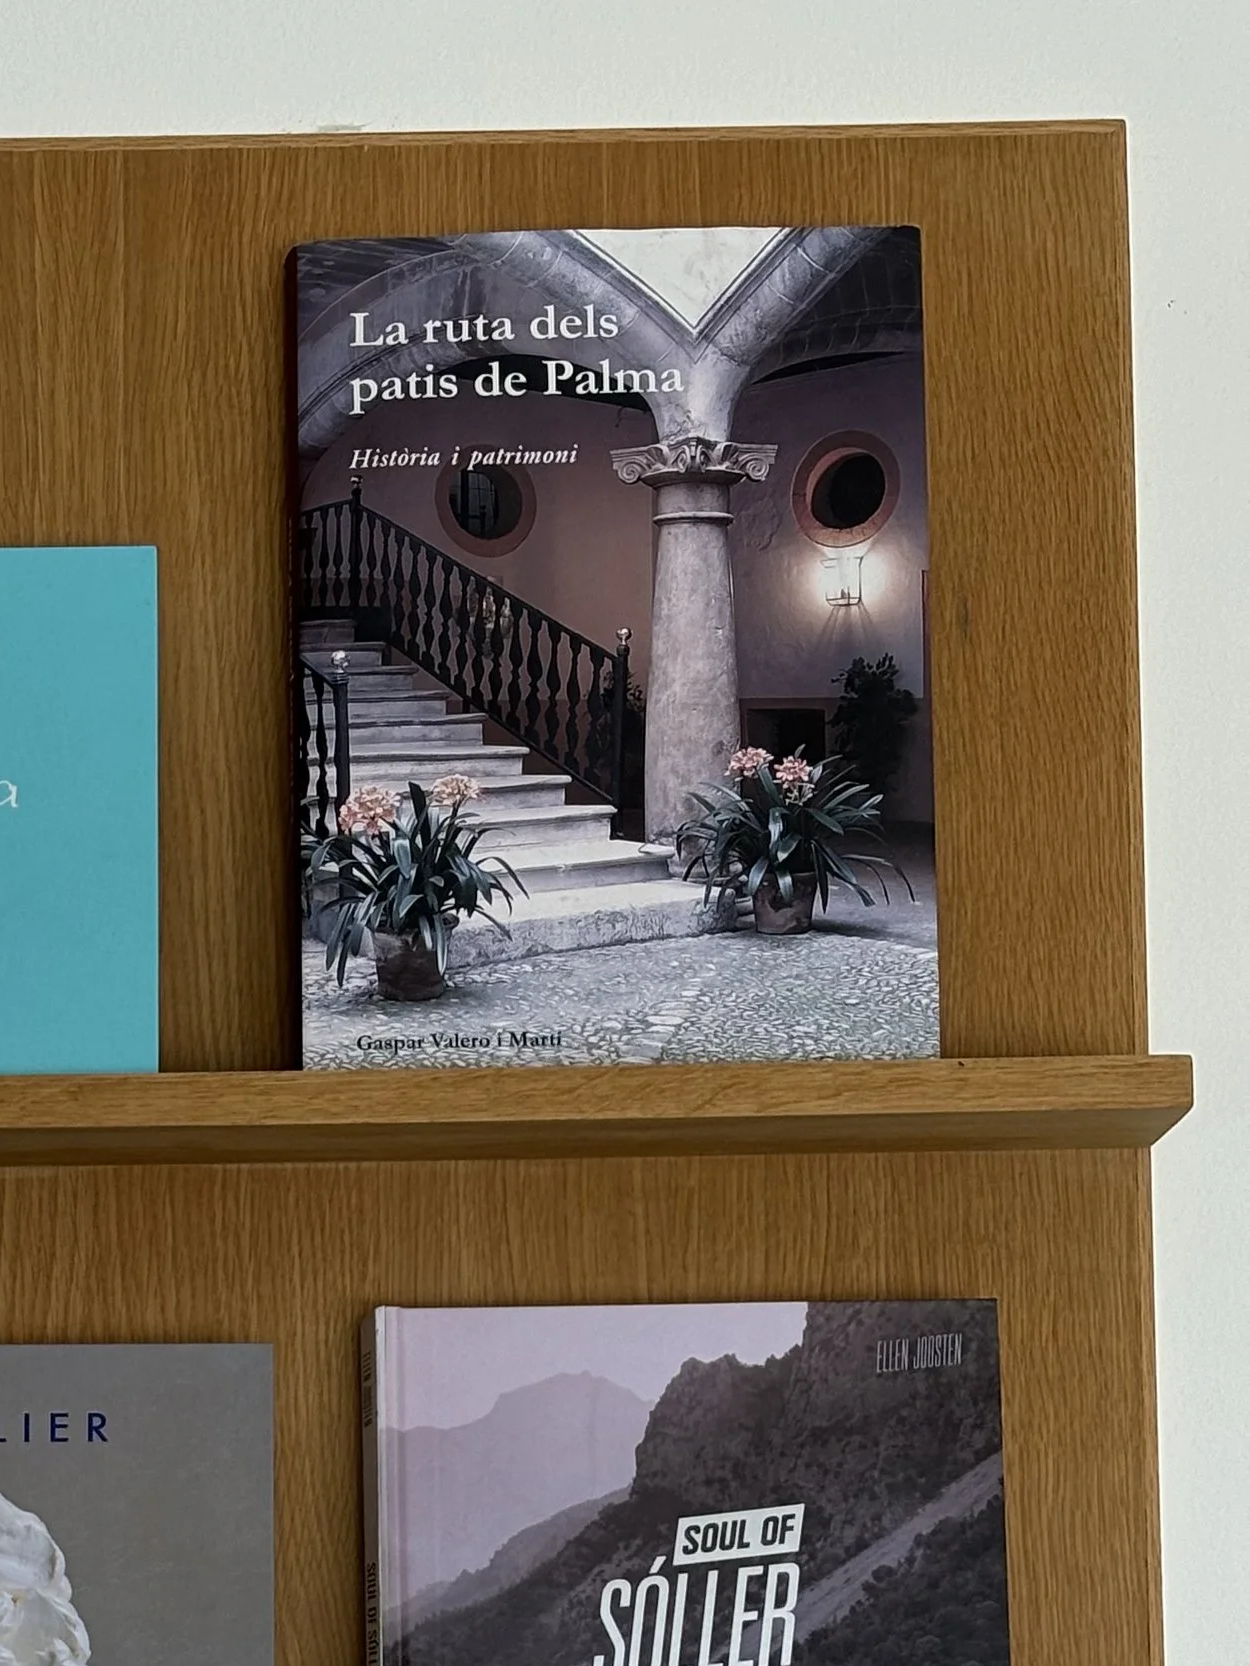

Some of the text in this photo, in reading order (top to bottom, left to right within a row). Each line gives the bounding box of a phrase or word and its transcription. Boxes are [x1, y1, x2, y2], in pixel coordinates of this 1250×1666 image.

[350, 303, 618, 348] La ruta dels
[349, 358, 684, 416] patis de Palma
[349, 443, 579, 471] Història i patrimoni
[356, 1035, 424, 1056] Gaspar
[430, 1032, 490, 1048] Valero
[497, 1031, 503, 1047] i
[876, 1332, 963, 1373] ELLEN JOOSTEN
[681, 1513, 796, 1556] SOUL OF
